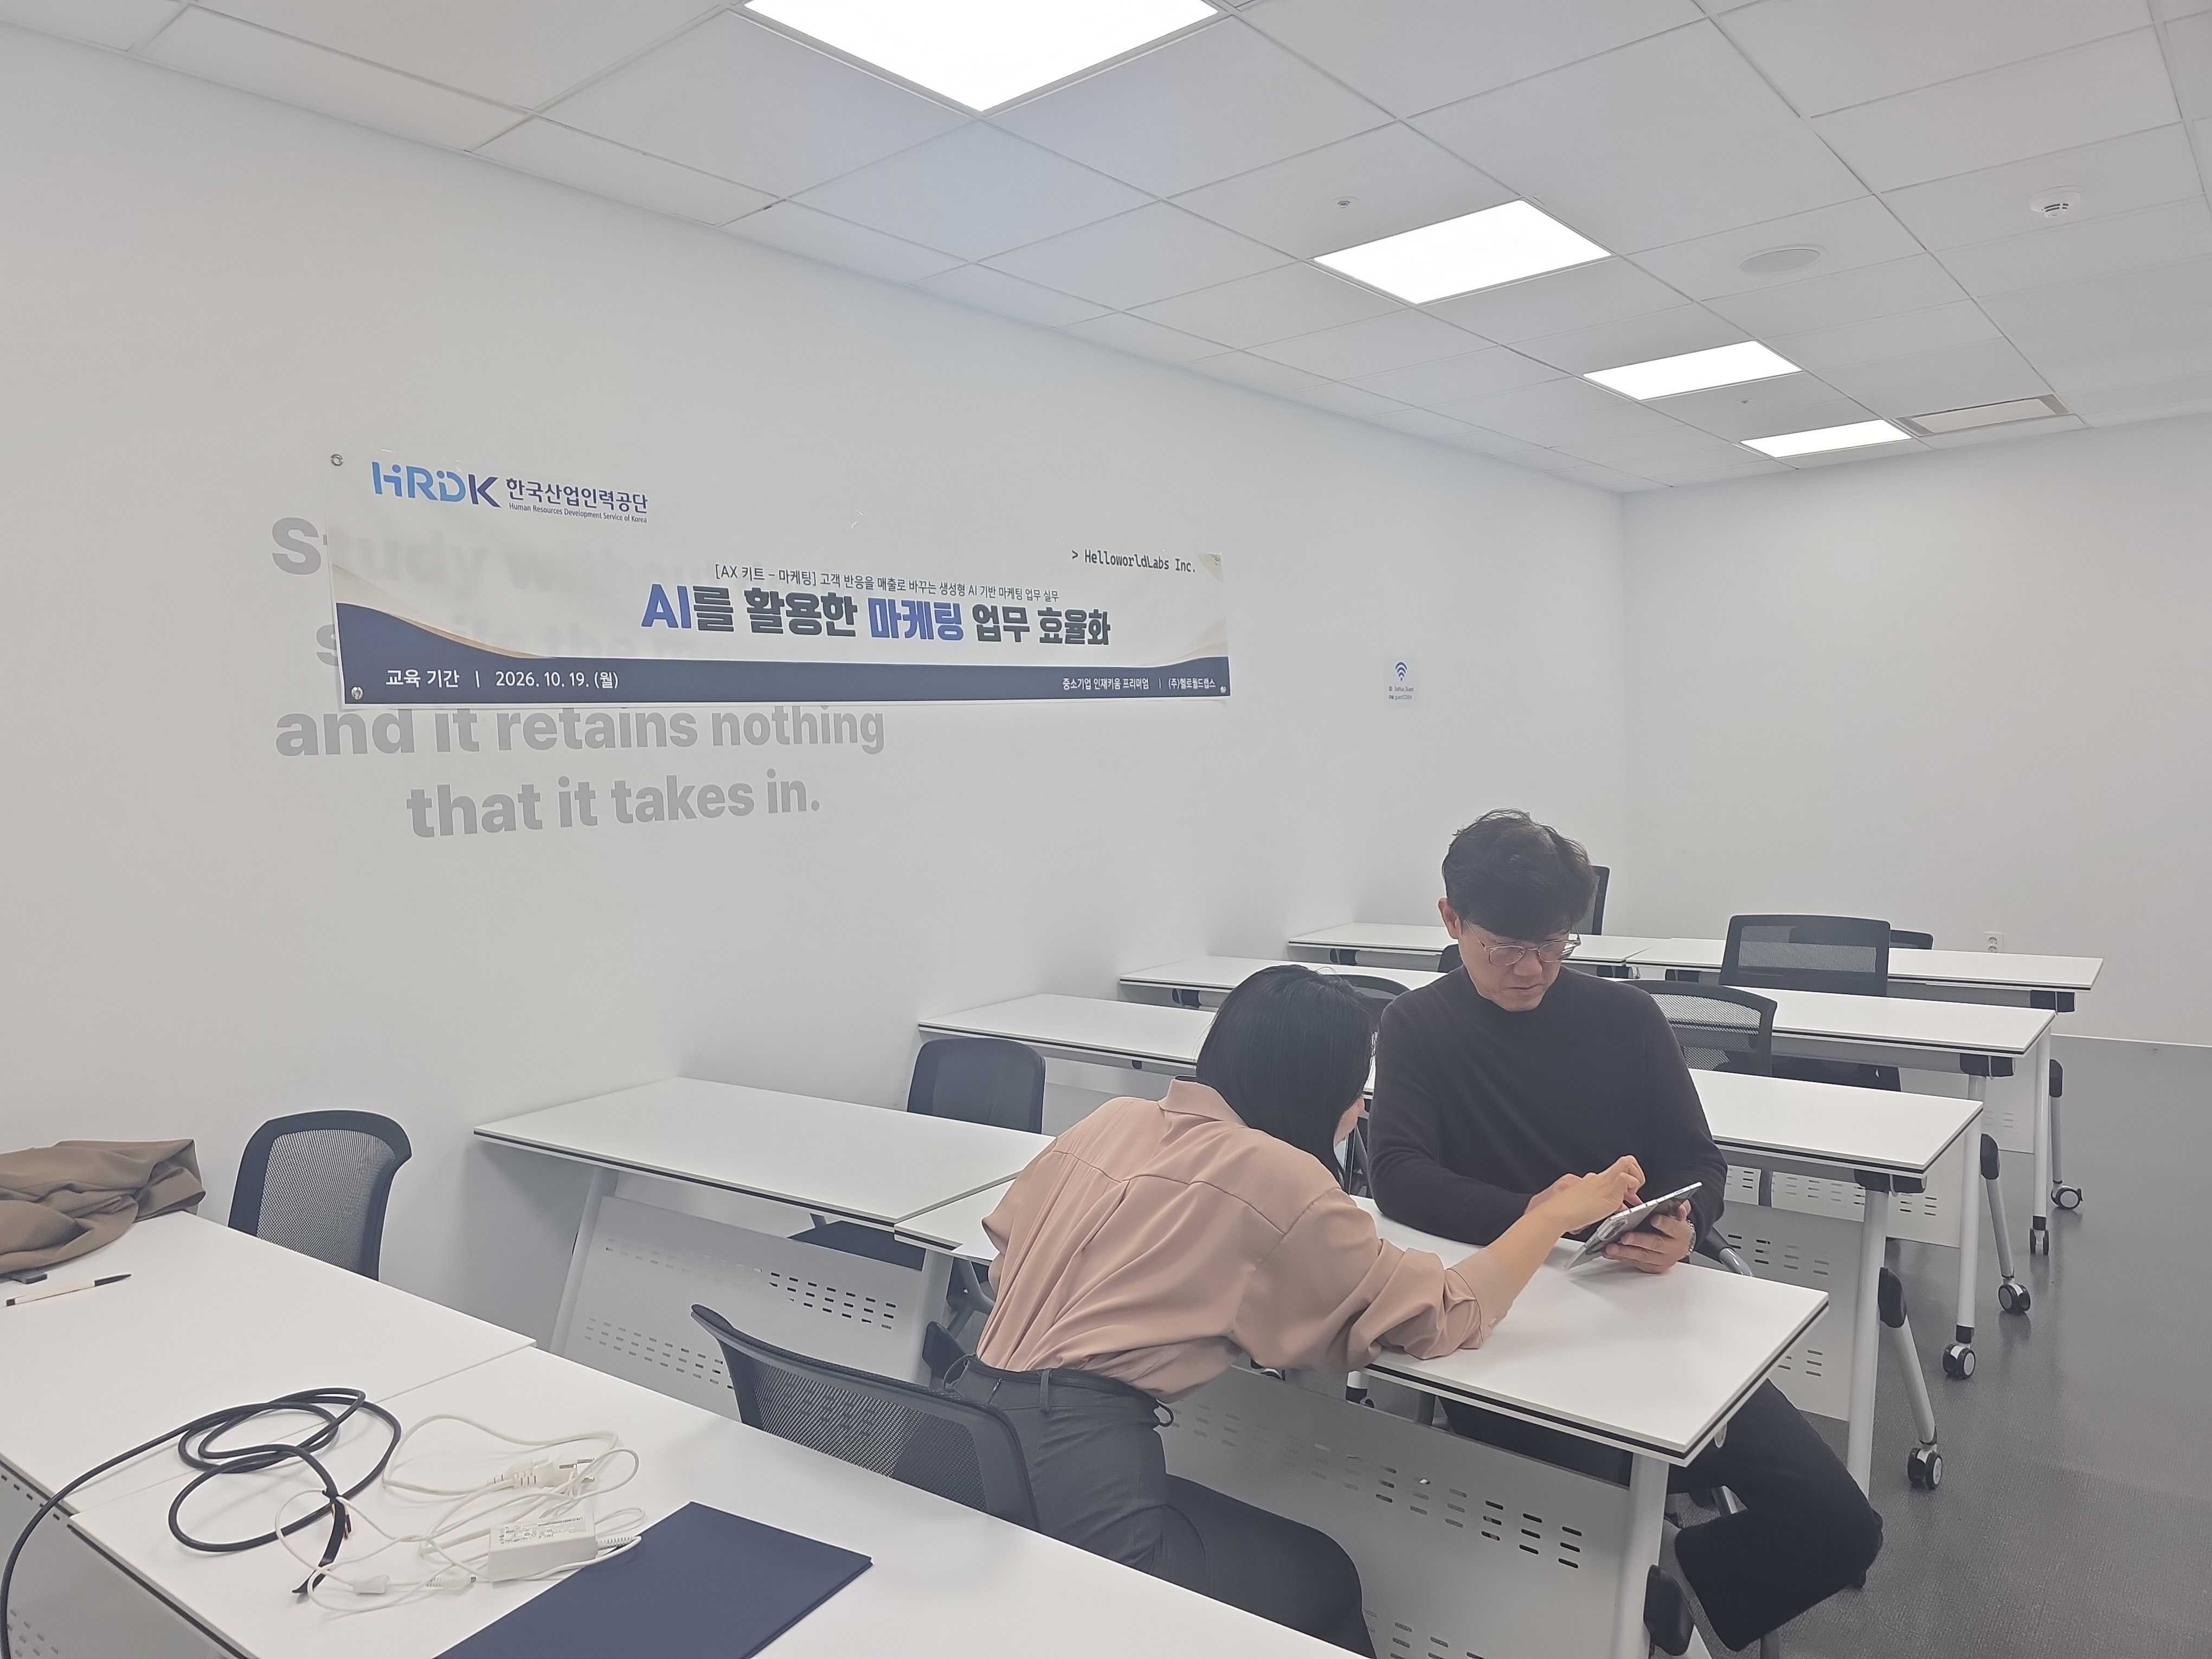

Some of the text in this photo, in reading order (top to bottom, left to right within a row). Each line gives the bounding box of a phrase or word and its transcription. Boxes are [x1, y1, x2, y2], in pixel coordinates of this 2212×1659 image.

[506, 478, 648, 513] 한국산업인력공단
[509, 503, 531, 512] Human
[533, 504, 563, 515] Resources
[564, 509, 602, 519] Development
[603, 513, 623, 521] Service
[1085, 549, 1169, 570] HelloworldLabs
[1175, 558, 1195, 573] Inc.
[715, 564, 738, 580] [AX
[742, 567, 765, 581] 키트
[779, 570, 816, 586] 마케팅]
[820, 573, 841, 588] 고객
[844, 575, 874, 590] 반응을
[877, 577, 906, 592] 매출로
[909, 580, 936, 594] 바꾸는
[939, 582, 965, 596] 생성형
[968, 585, 977, 596] AI
[980, 585, 996, 599] 기반
[998, 587, 1023, 600] 마케팅
[1025, 589, 1041, 601] 업무
[1043, 589, 1059, 602] 실무
[641, 583, 1111, 645] AI를 활용한 마케팅 업무 효율화
[385, 668, 421, 688] 교육
[426, 669, 460, 688] 기간
[496, 671, 539, 687] 2026.
[544, 672, 565, 687] 10.
[569, 672, 589, 687] 19.
[594, 671, 619, 689] (월)
[1063, 678, 1091, 690] 중소기업
[1094, 678, 1121, 690] 인재키움
[1123, 678, 1149, 690] 프리미엄
[1168, 678, 1216, 690] (주)헬로월드랩스
[275, 705, 885, 757] and it retains nothing
[406, 768, 820, 838] that it takes in.
